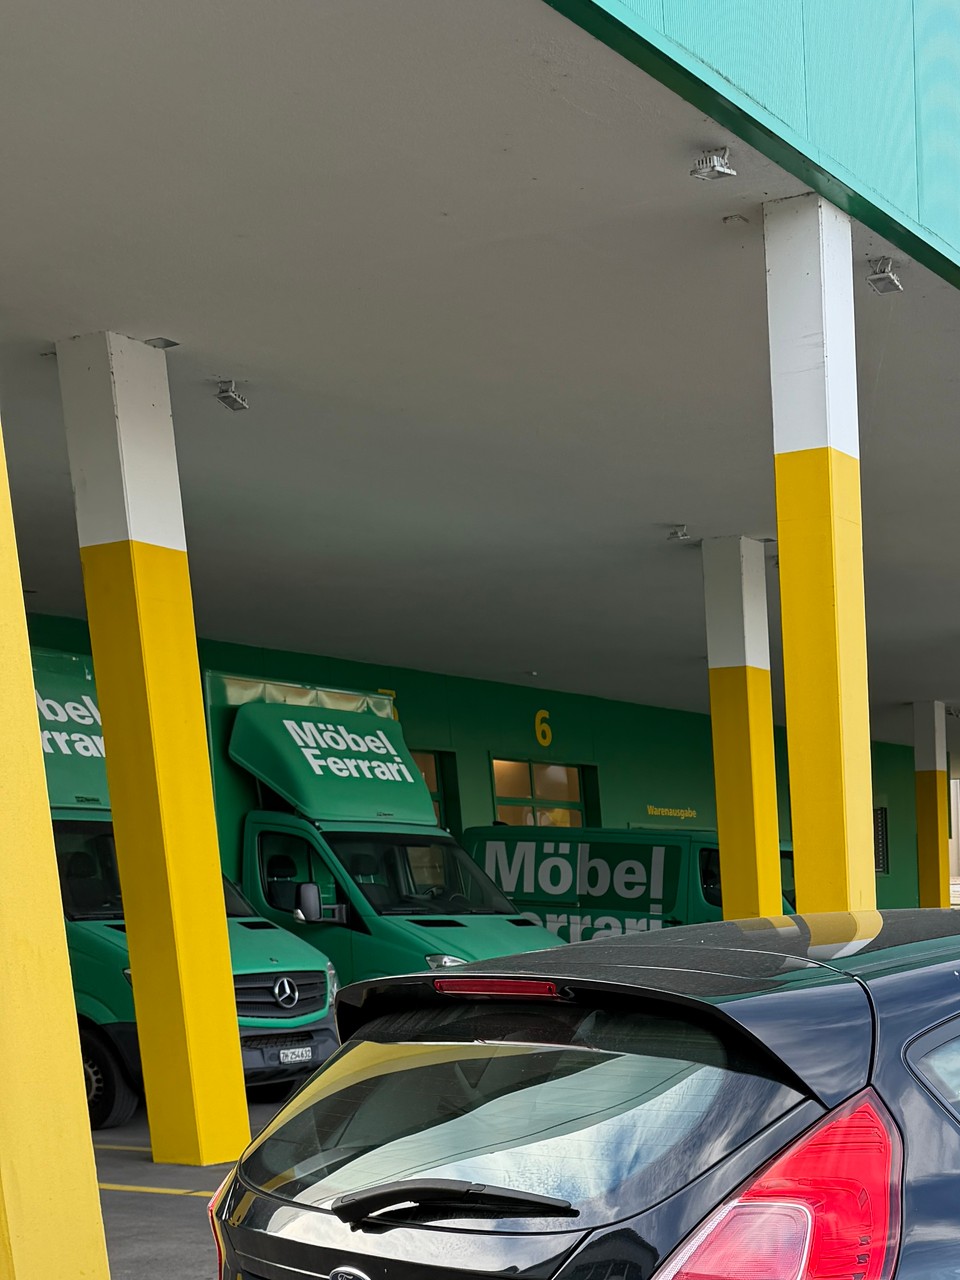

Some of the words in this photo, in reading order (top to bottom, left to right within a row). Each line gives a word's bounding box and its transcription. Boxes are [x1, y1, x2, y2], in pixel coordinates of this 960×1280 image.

[35, 689, 102, 726] bel
[283, 720, 397, 755] Möbel
[534, 709, 552, 747] 6
[301, 748, 414, 783] Ferrari
[647, 804, 697, 820] Warenausgabe
[485, 841, 665, 898] Möbel
